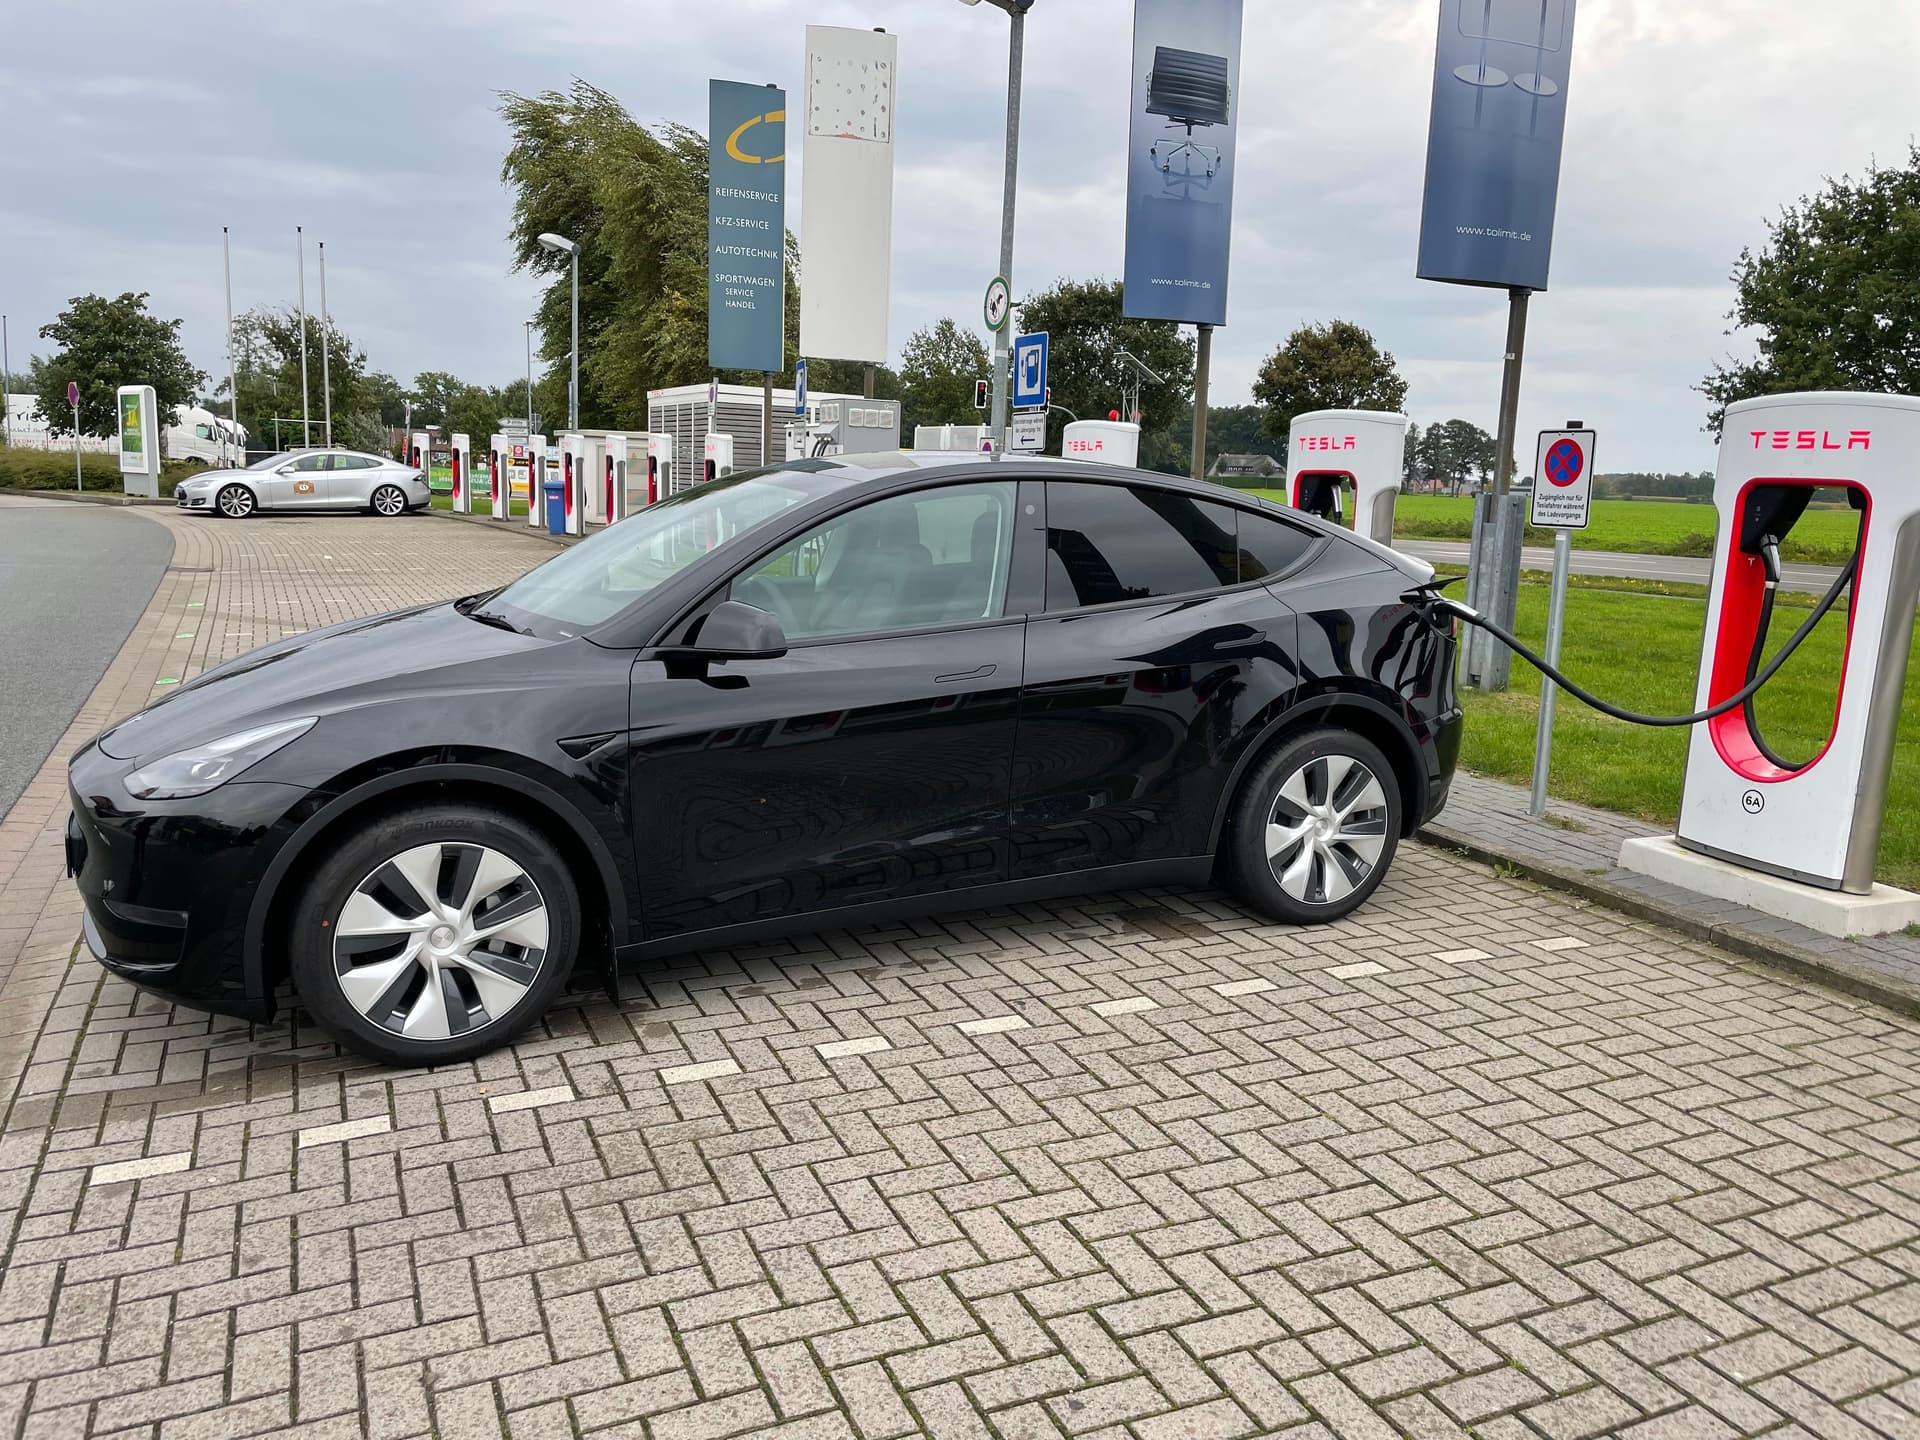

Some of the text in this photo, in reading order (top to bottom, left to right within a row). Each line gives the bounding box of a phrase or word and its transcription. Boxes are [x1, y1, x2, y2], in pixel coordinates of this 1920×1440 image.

[715, 187, 779, 203] REIFENSERVICE
[715, 216, 769, 230] KFZ-SERVICE
[1455, 226, 1532, 241] www.tolimit.de
[715, 245, 778, 260] AUTOTECHNIK
[715, 273, 775, 288] SPORTWAGEN
[1150, 278, 1211, 289] www.tolimit.de
[725, 288, 754, 297] SERVICE
[725, 301, 756, 310] HANDEL
[1067, 440, 1103, 452] TESLA
[1299, 437, 1356, 450] TESLA
[1750, 431, 1872, 450] TESLA
[1745, 796, 1761, 808] 6A
